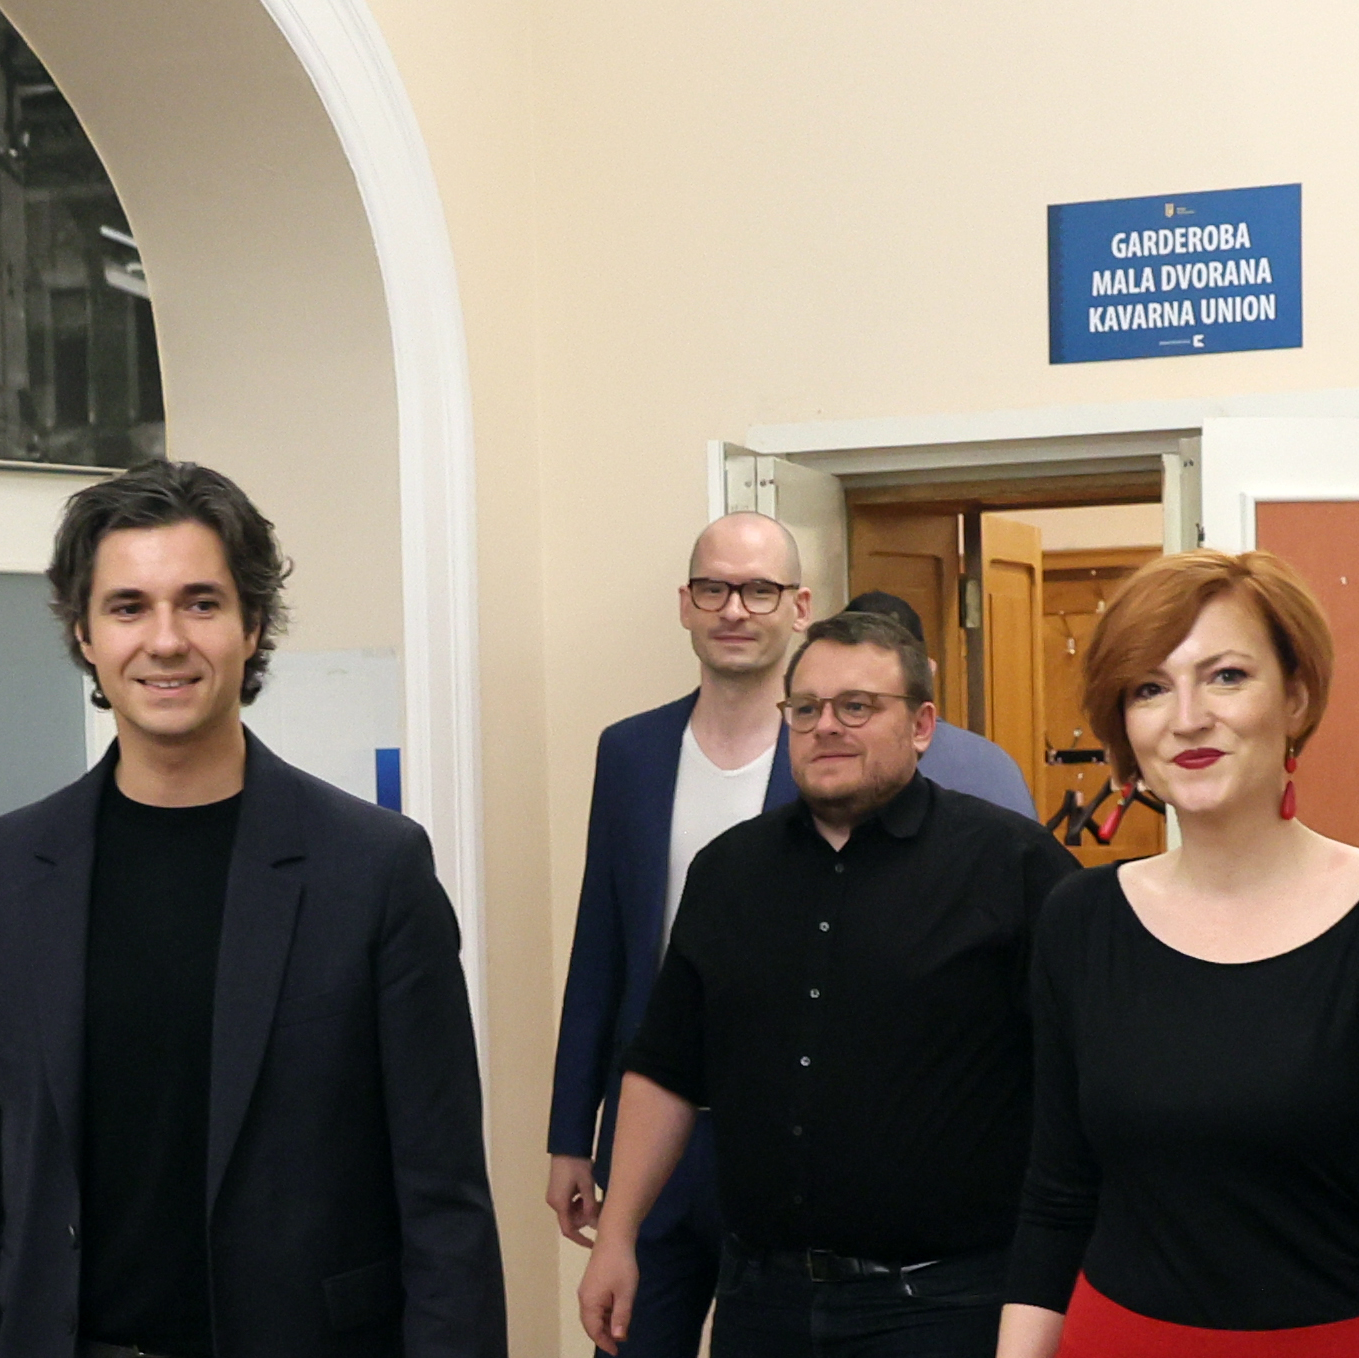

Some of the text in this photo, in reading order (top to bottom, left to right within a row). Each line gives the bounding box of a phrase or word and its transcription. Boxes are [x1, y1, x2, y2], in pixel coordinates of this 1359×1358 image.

[1111, 222, 1251, 259] GARDEROBA
[1092, 257, 1272, 297] MALA DVORANA
[1089, 294, 1276, 332] KAVARNA UNION
